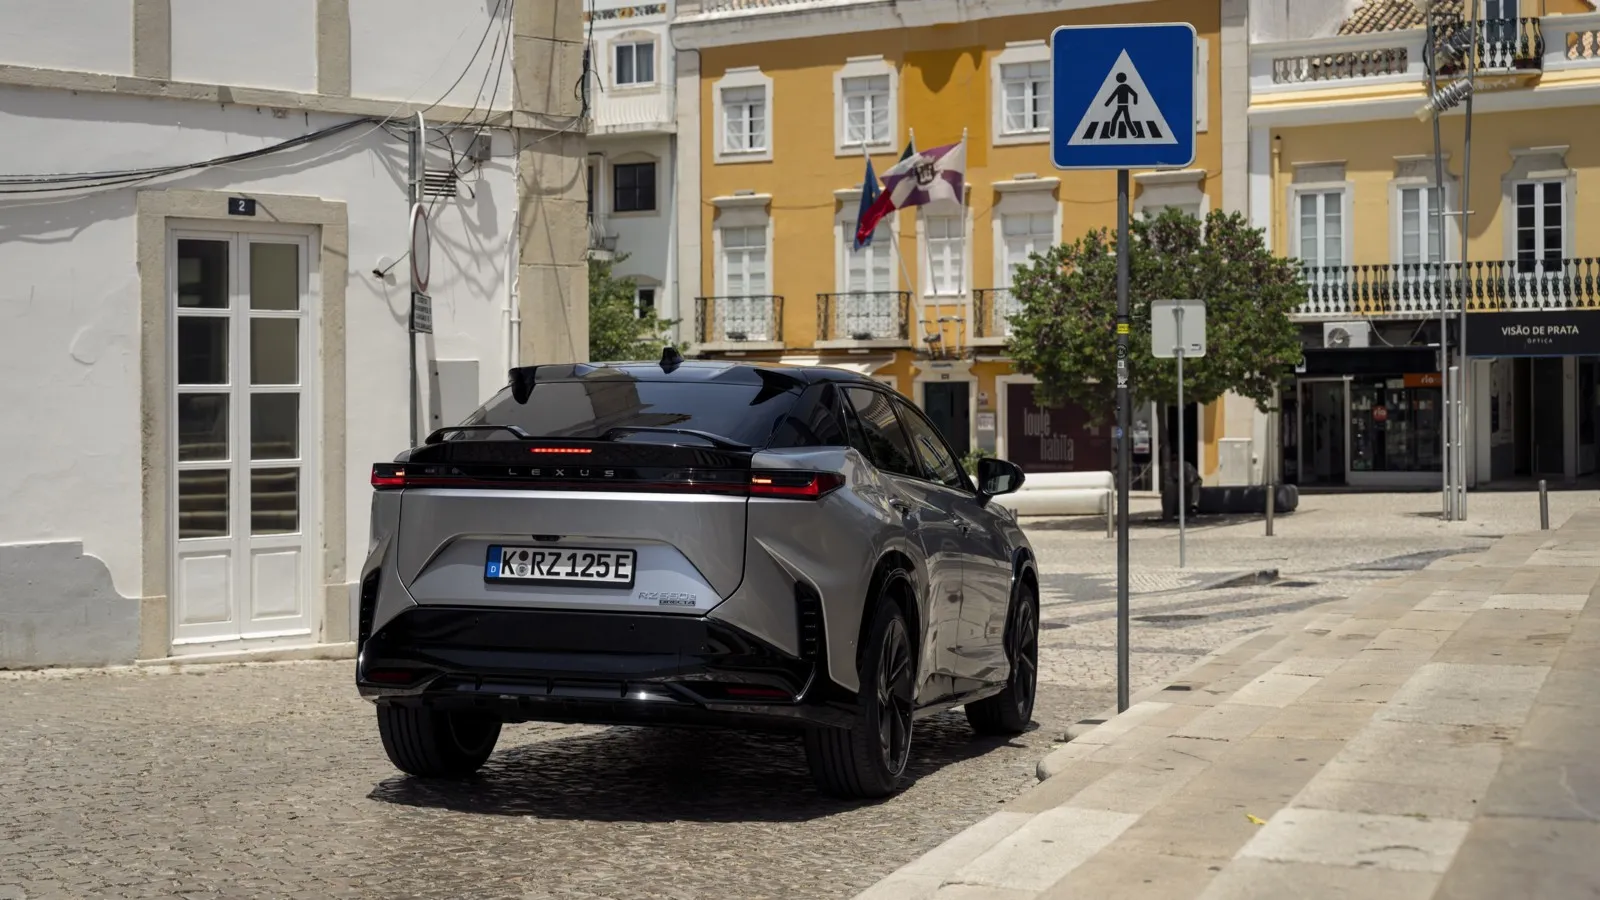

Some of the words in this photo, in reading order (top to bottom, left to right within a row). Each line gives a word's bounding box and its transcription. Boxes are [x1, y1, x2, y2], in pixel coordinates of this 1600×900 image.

[238, 200, 246, 212] 2
[1501, 324, 1530, 336] VISÃO
[1532, 326, 1545, 335] DE
[1547, 325, 1579, 335] PRATA
[508, 468, 615, 477] LEXUS
